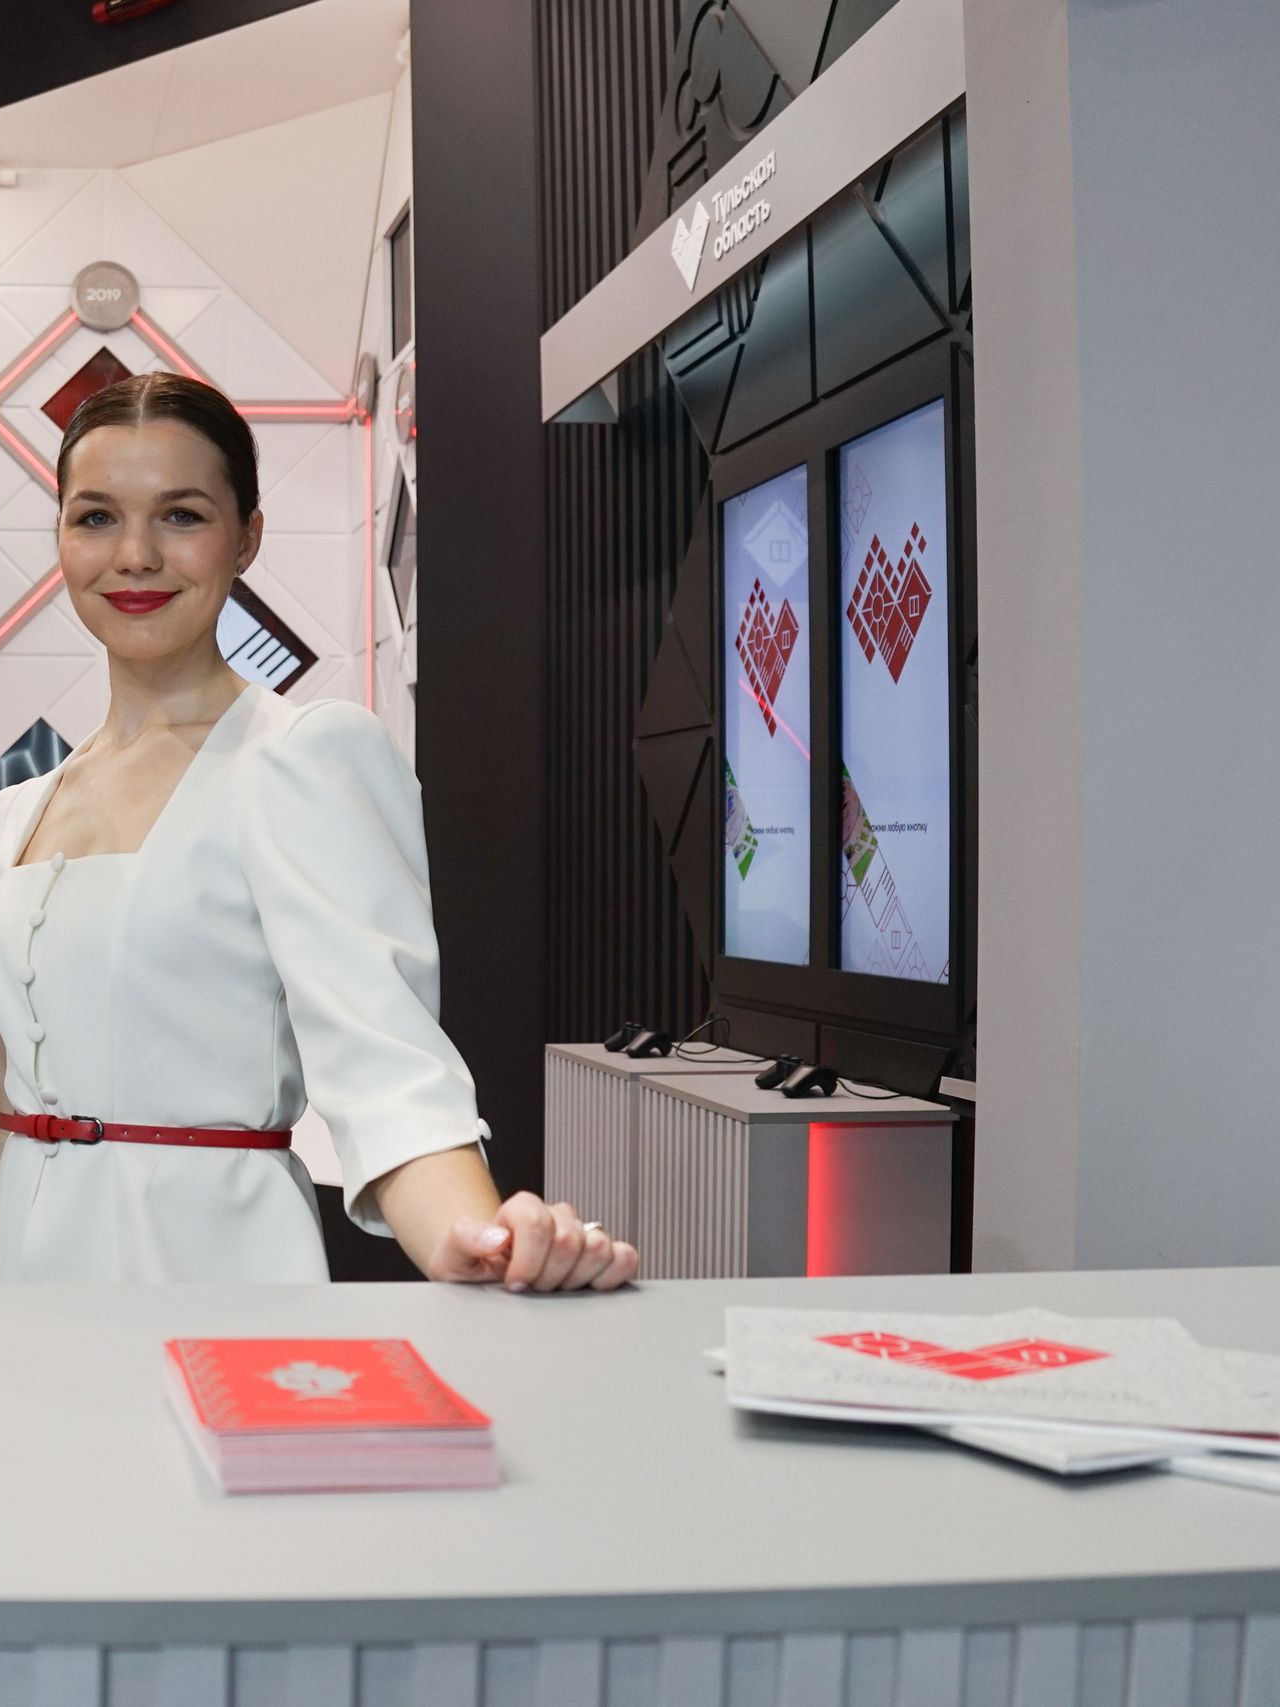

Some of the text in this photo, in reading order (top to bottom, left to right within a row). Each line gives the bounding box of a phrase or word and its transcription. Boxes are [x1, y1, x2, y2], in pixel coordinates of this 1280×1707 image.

[712, 150, 776, 224] Тульская
[714, 199, 771, 260] область
[86, 287, 122, 302] 2019
